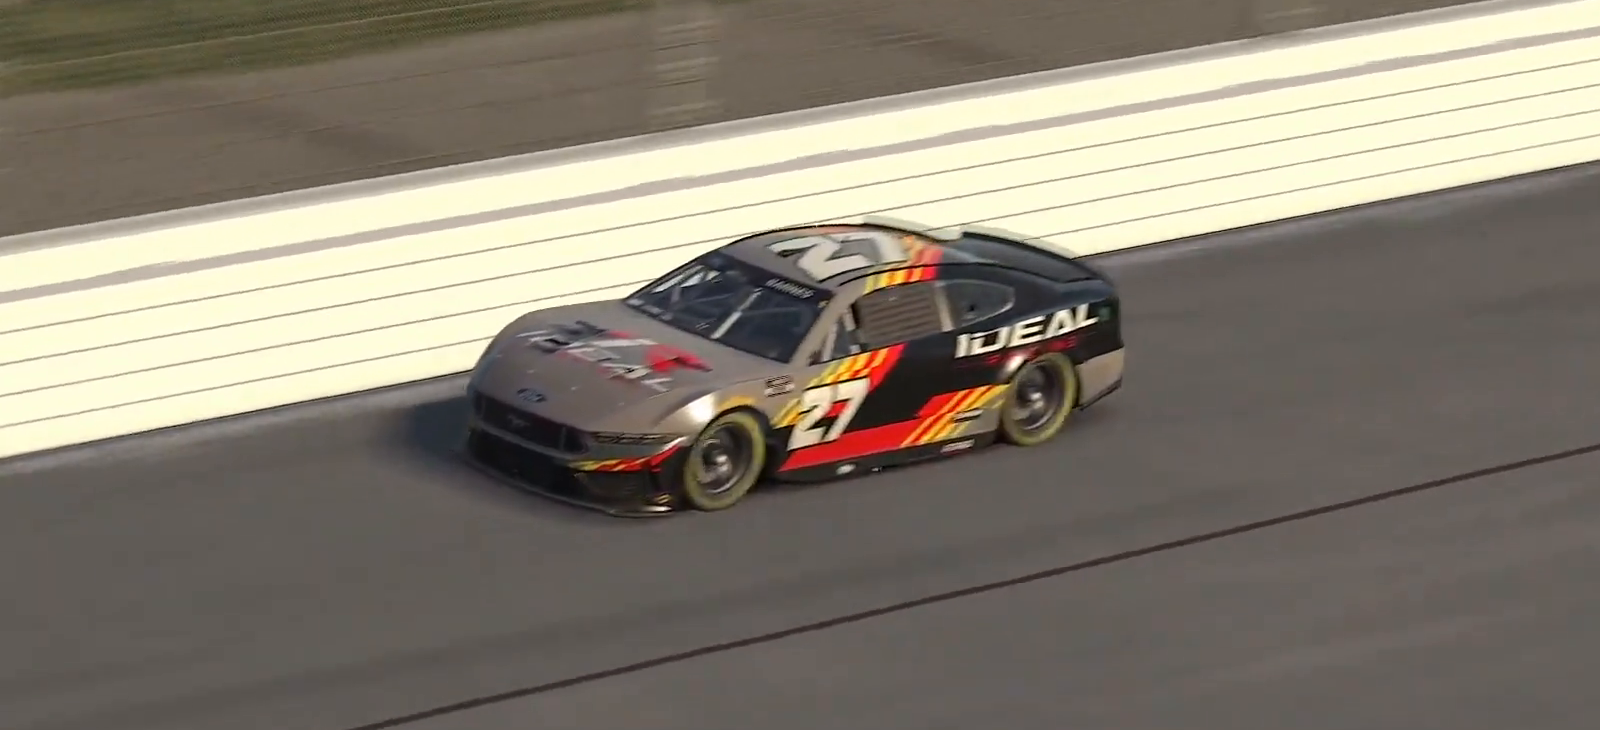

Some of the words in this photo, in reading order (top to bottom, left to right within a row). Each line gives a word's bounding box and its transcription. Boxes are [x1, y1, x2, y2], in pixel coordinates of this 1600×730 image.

[767, 231, 907, 283] 27
[954, 303, 1099, 359] IDEAL
[786, 377, 871, 452] 27
